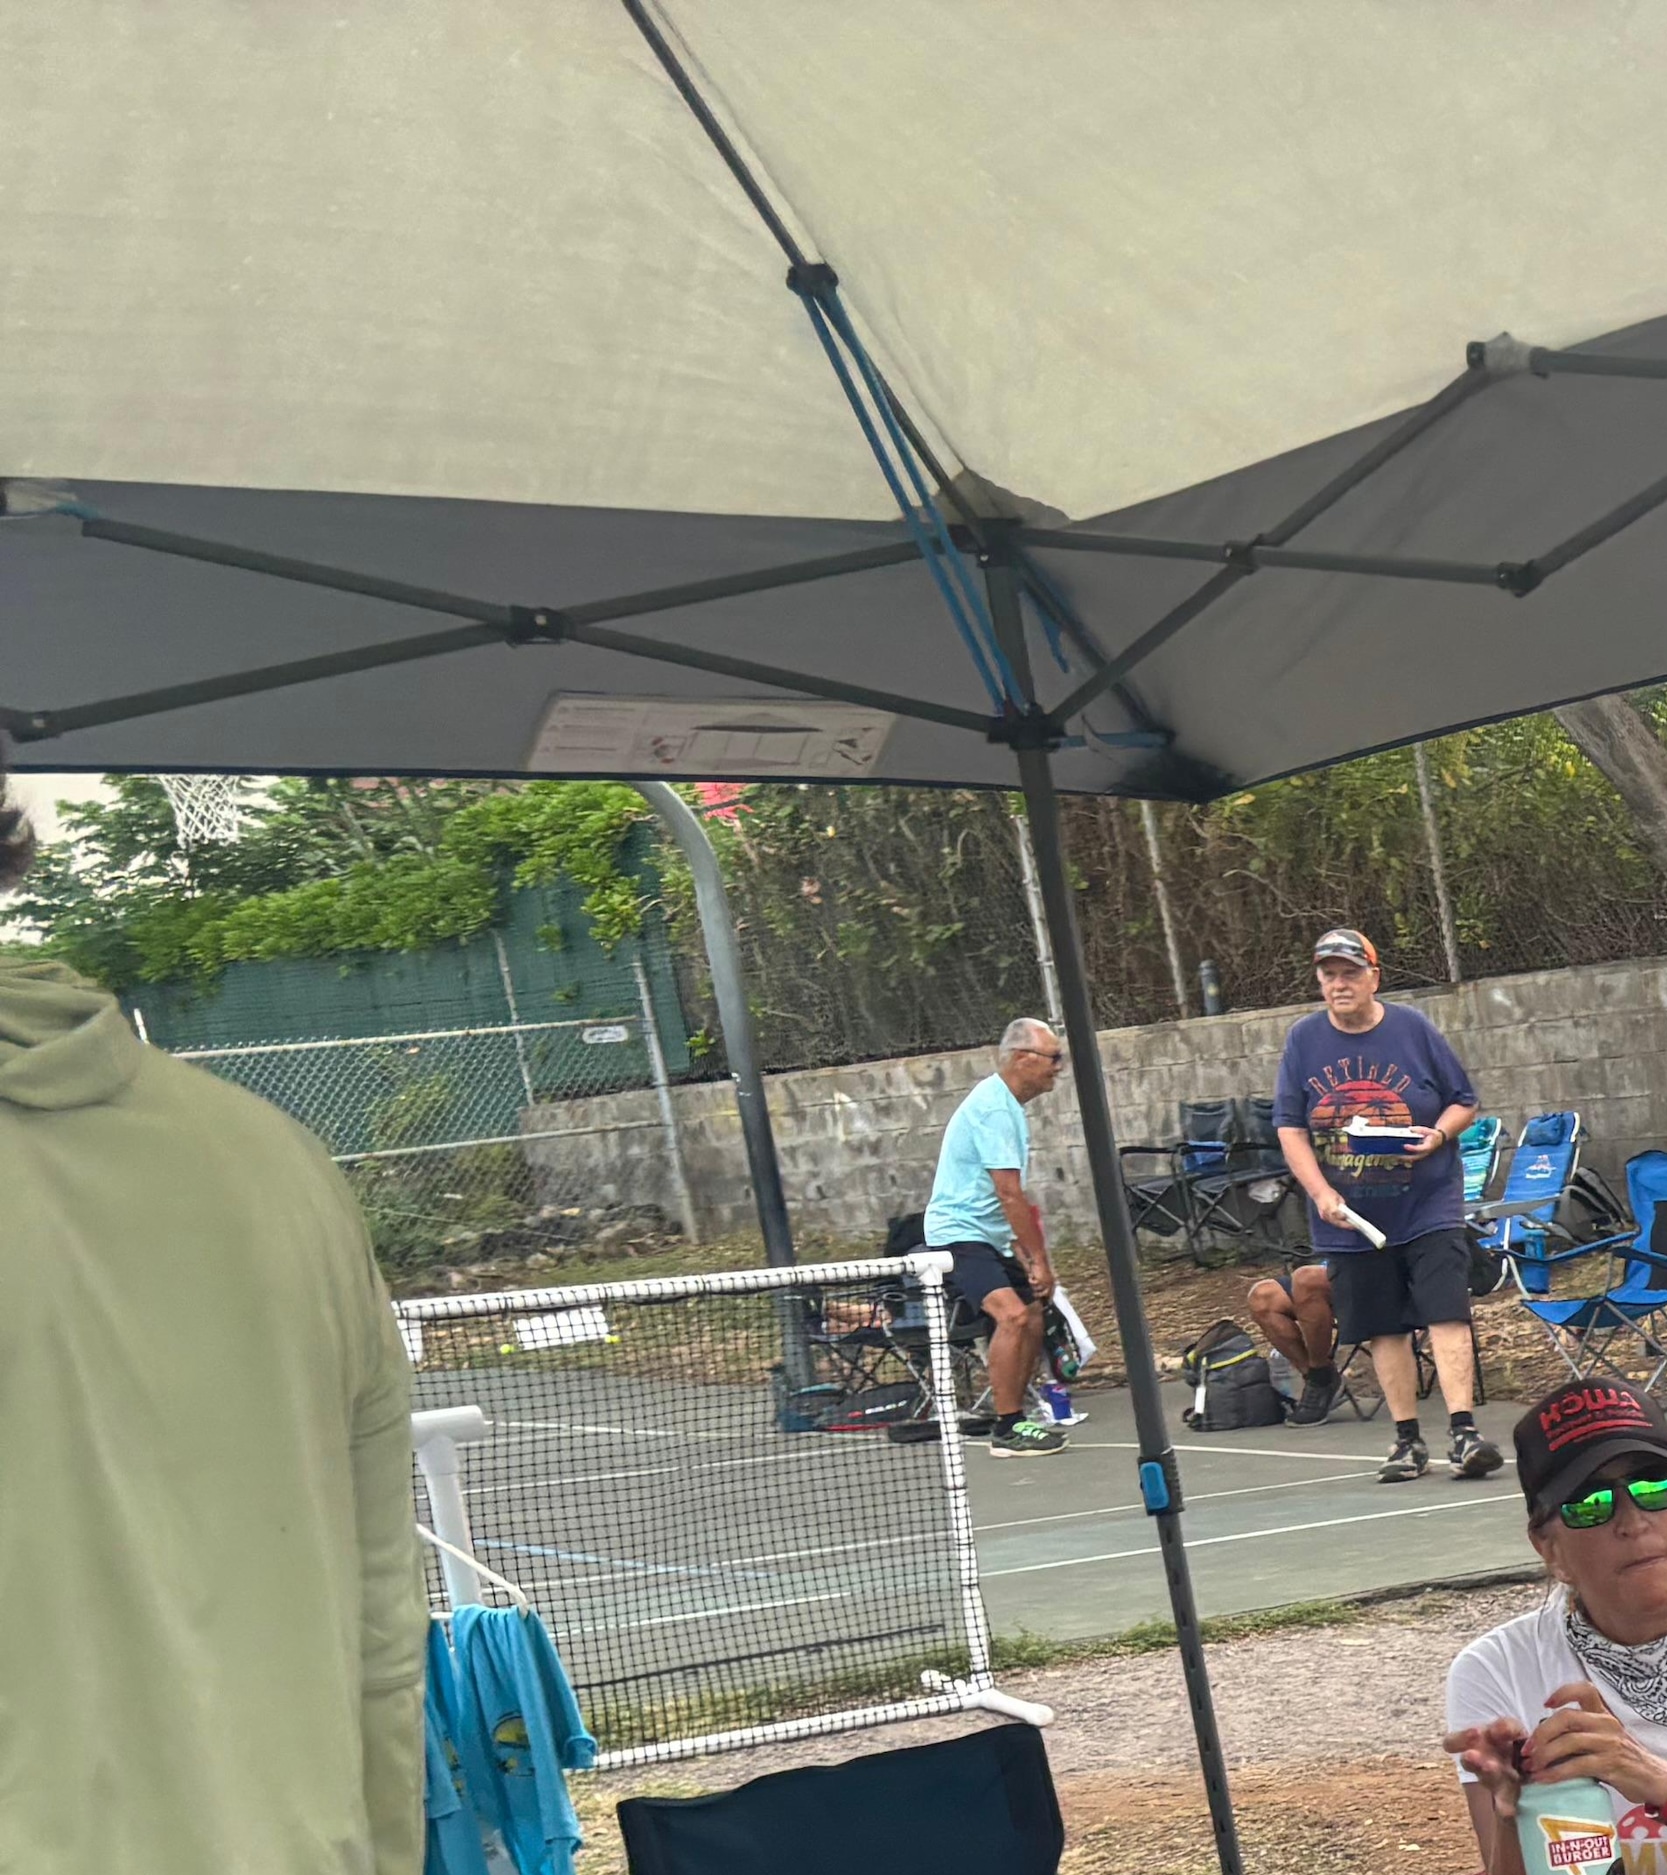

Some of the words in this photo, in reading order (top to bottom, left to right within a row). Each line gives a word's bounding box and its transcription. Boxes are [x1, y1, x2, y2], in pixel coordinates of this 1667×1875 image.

[1308, 1055, 1412, 1097] RETIRED
[1551, 1835, 1609, 1855] IN-N-OUT
[1553, 1846, 1611, 1865] BURGER
